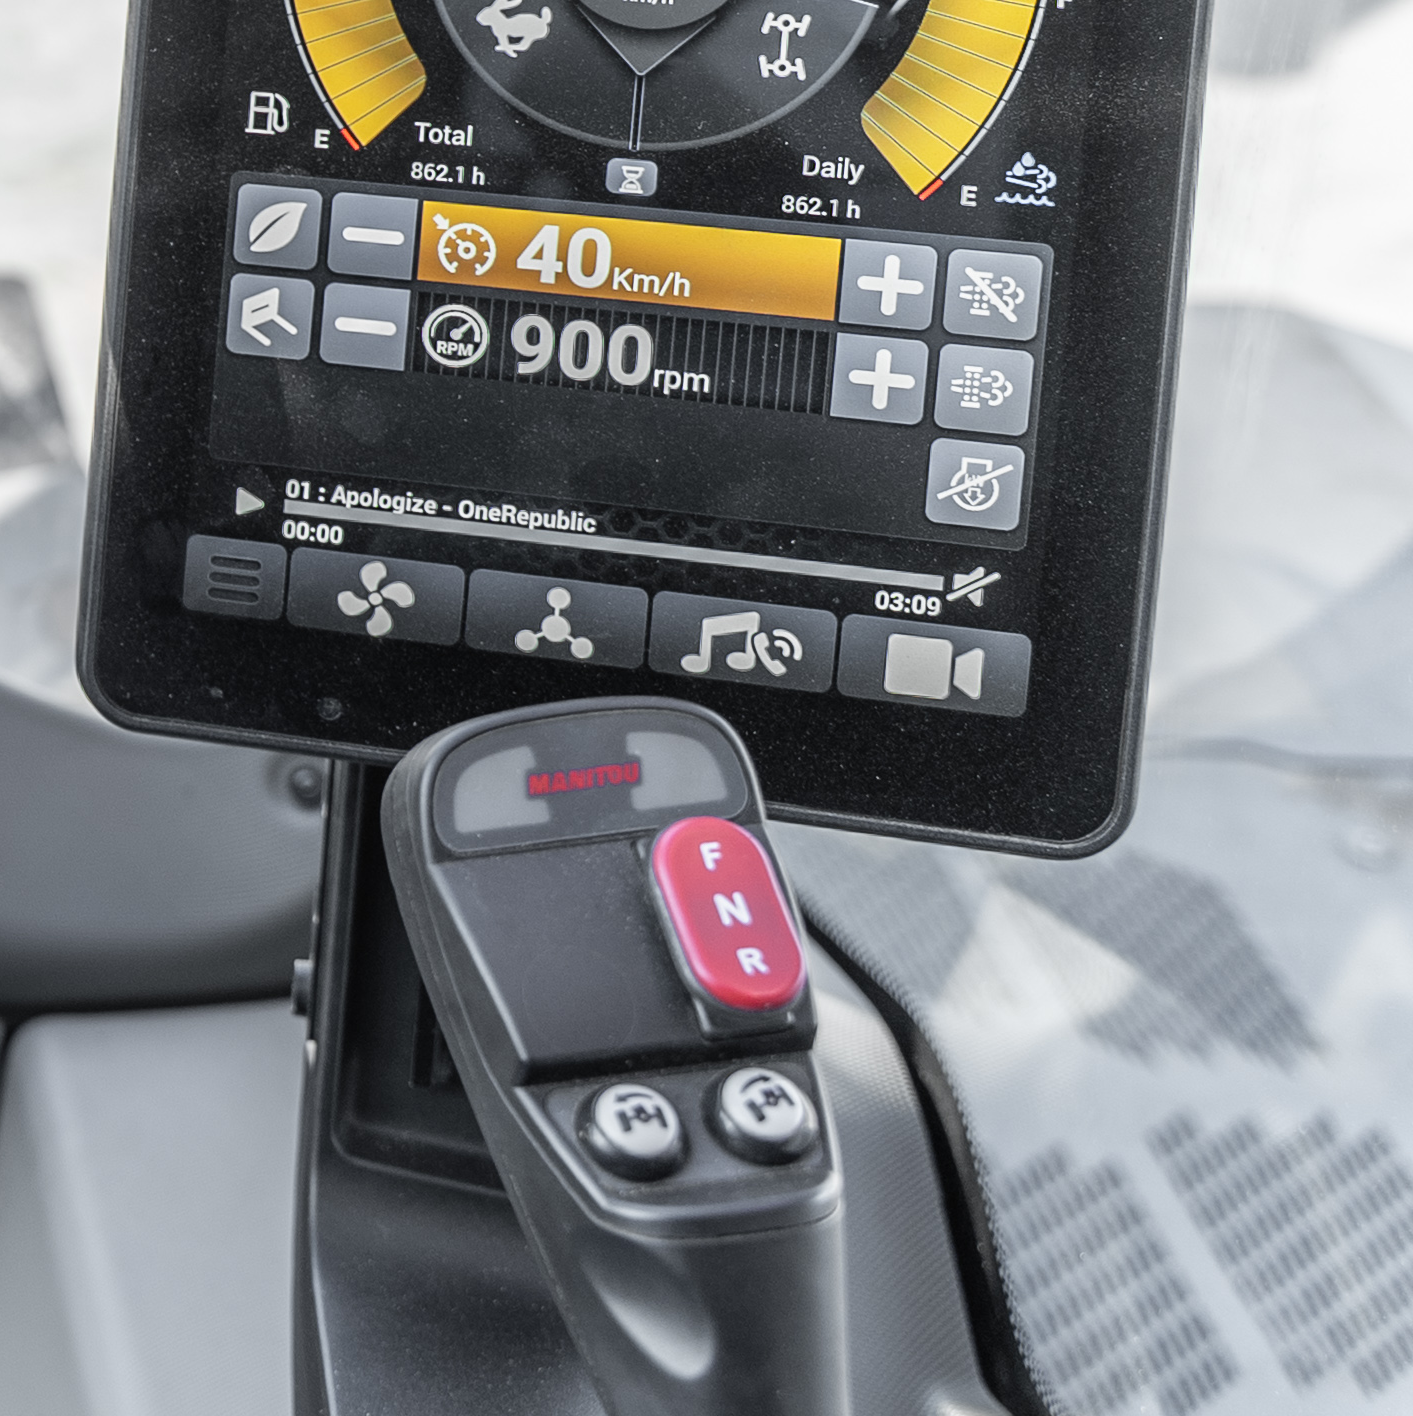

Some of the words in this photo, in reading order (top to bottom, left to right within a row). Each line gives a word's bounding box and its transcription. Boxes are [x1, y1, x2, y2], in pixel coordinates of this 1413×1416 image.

[313, 128, 331, 149] E
[414, 121, 474, 147] Total
[410, 161, 465, 184] 862.1
[471, 165, 486, 186] h
[801, 154, 865, 186] Daily
[781, 194, 839, 217] 862.1
[845, 198, 861, 219] h
[959, 184, 978, 207] E
[516, 224, 612, 289] 40
[612, 266, 691, 298] Km/h
[435, 338, 475, 359] RPM
[510, 313, 654, 386] 900
[652, 367, 712, 396] rpm
[285, 478, 312, 500] 01
[330, 485, 438, 515] Apologize
[457, 500, 597, 533] OneRepublic
[281, 519, 344, 545] 00:00
[874, 590, 942, 616] 03:09
[528, 762, 639, 795] MANITOU
[699, 841, 722, 871] F
[713, 891, 752, 927] N
[736, 947, 769, 975] R
